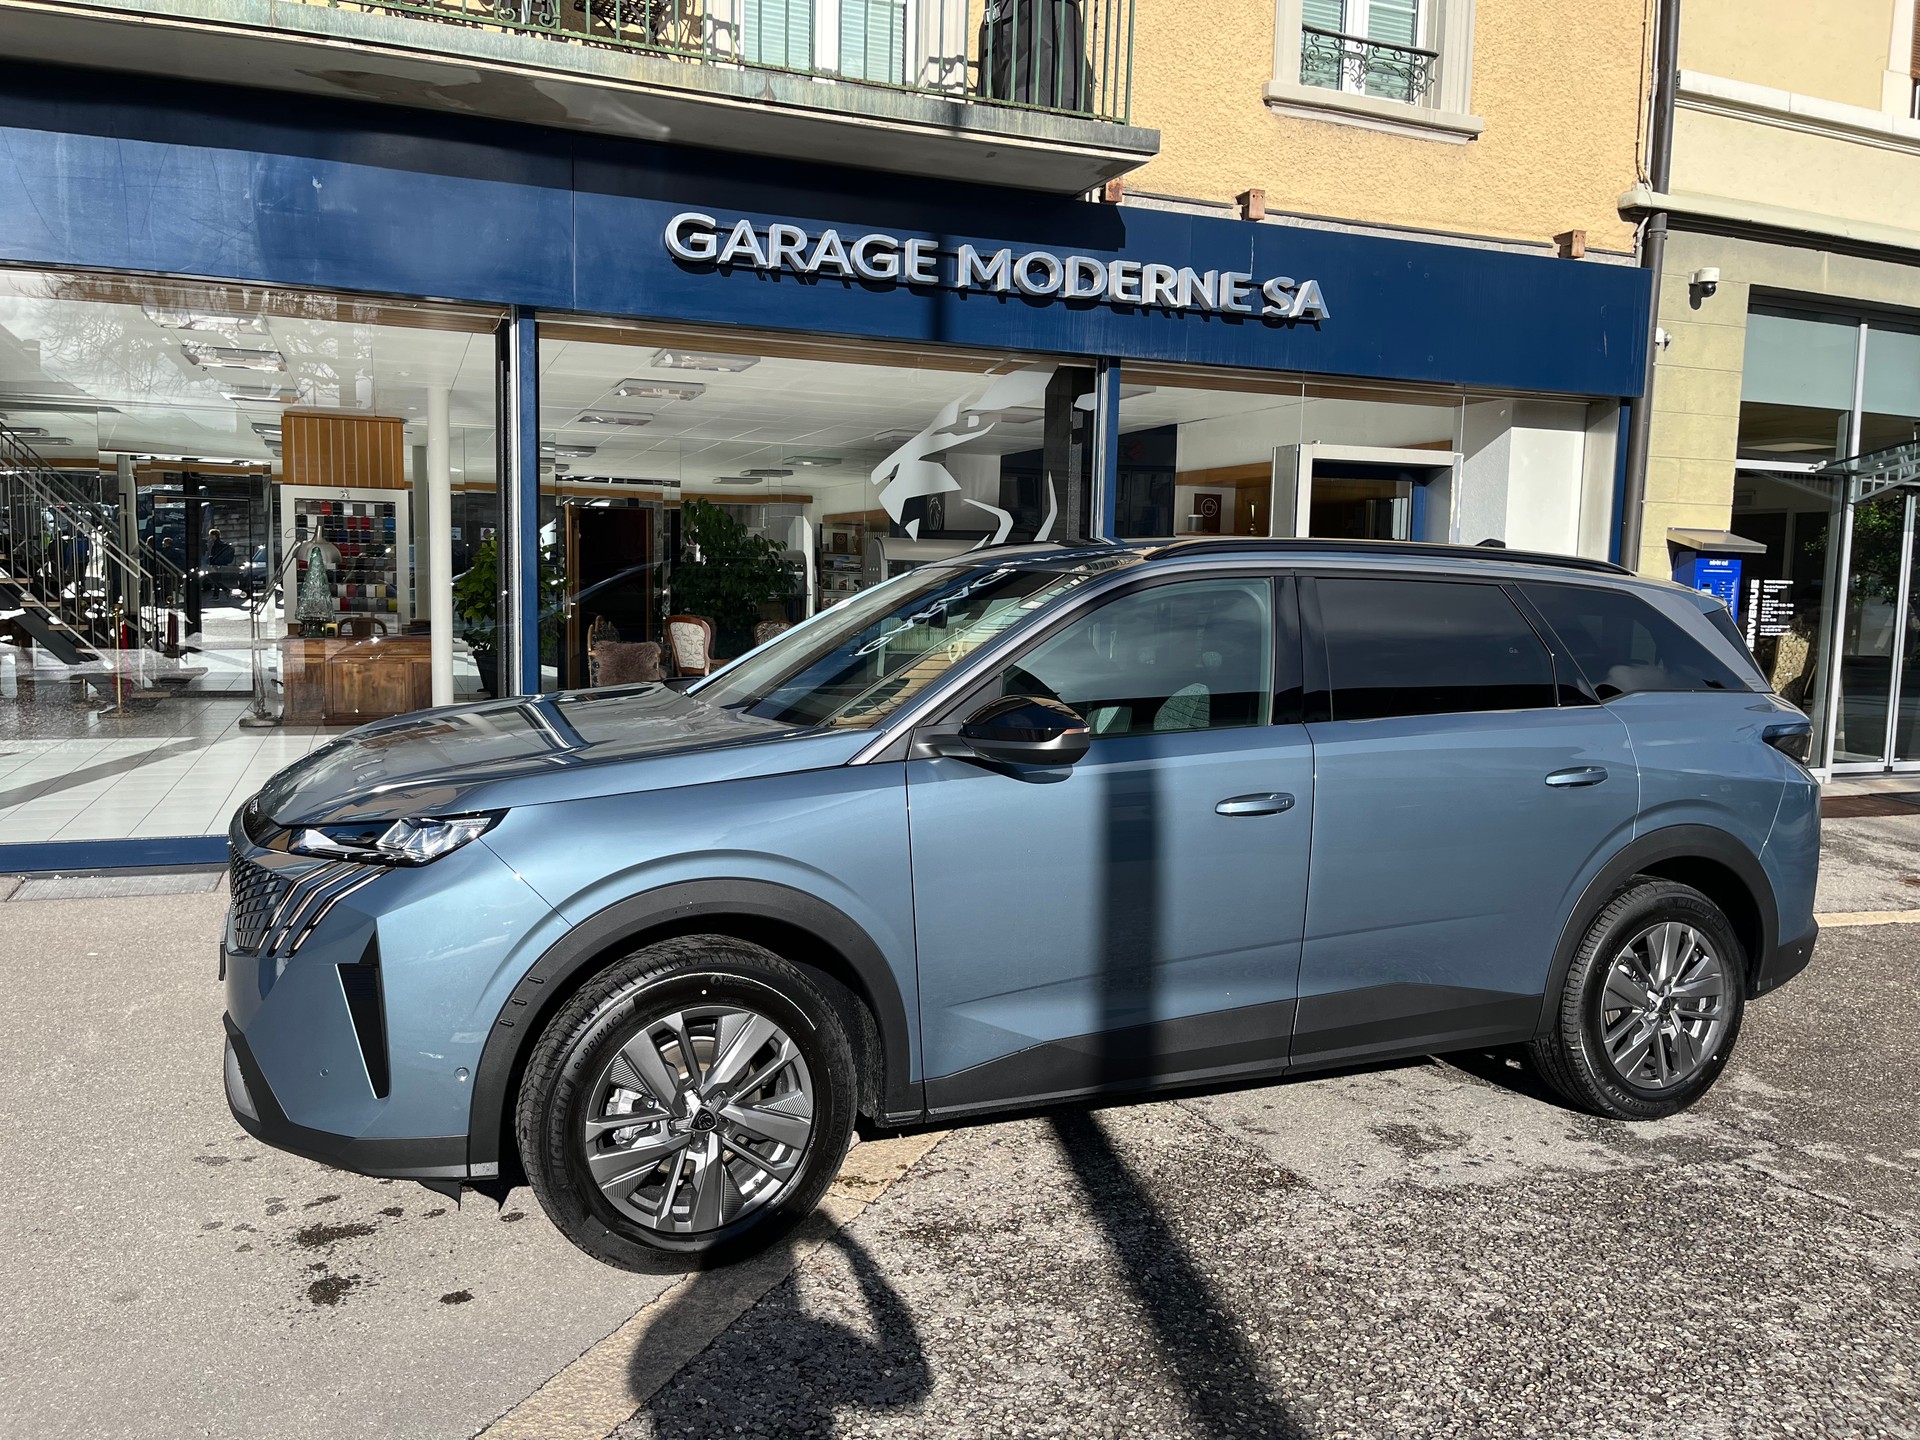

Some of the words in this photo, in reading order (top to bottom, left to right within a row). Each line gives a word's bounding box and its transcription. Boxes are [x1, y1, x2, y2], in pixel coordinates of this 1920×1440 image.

[664, 212, 938, 285] GARAGE
[958, 244, 1252, 314] MODERNE
[1262, 276, 1330, 320] SA
[548, 1084, 575, 1188] MICHELIN
